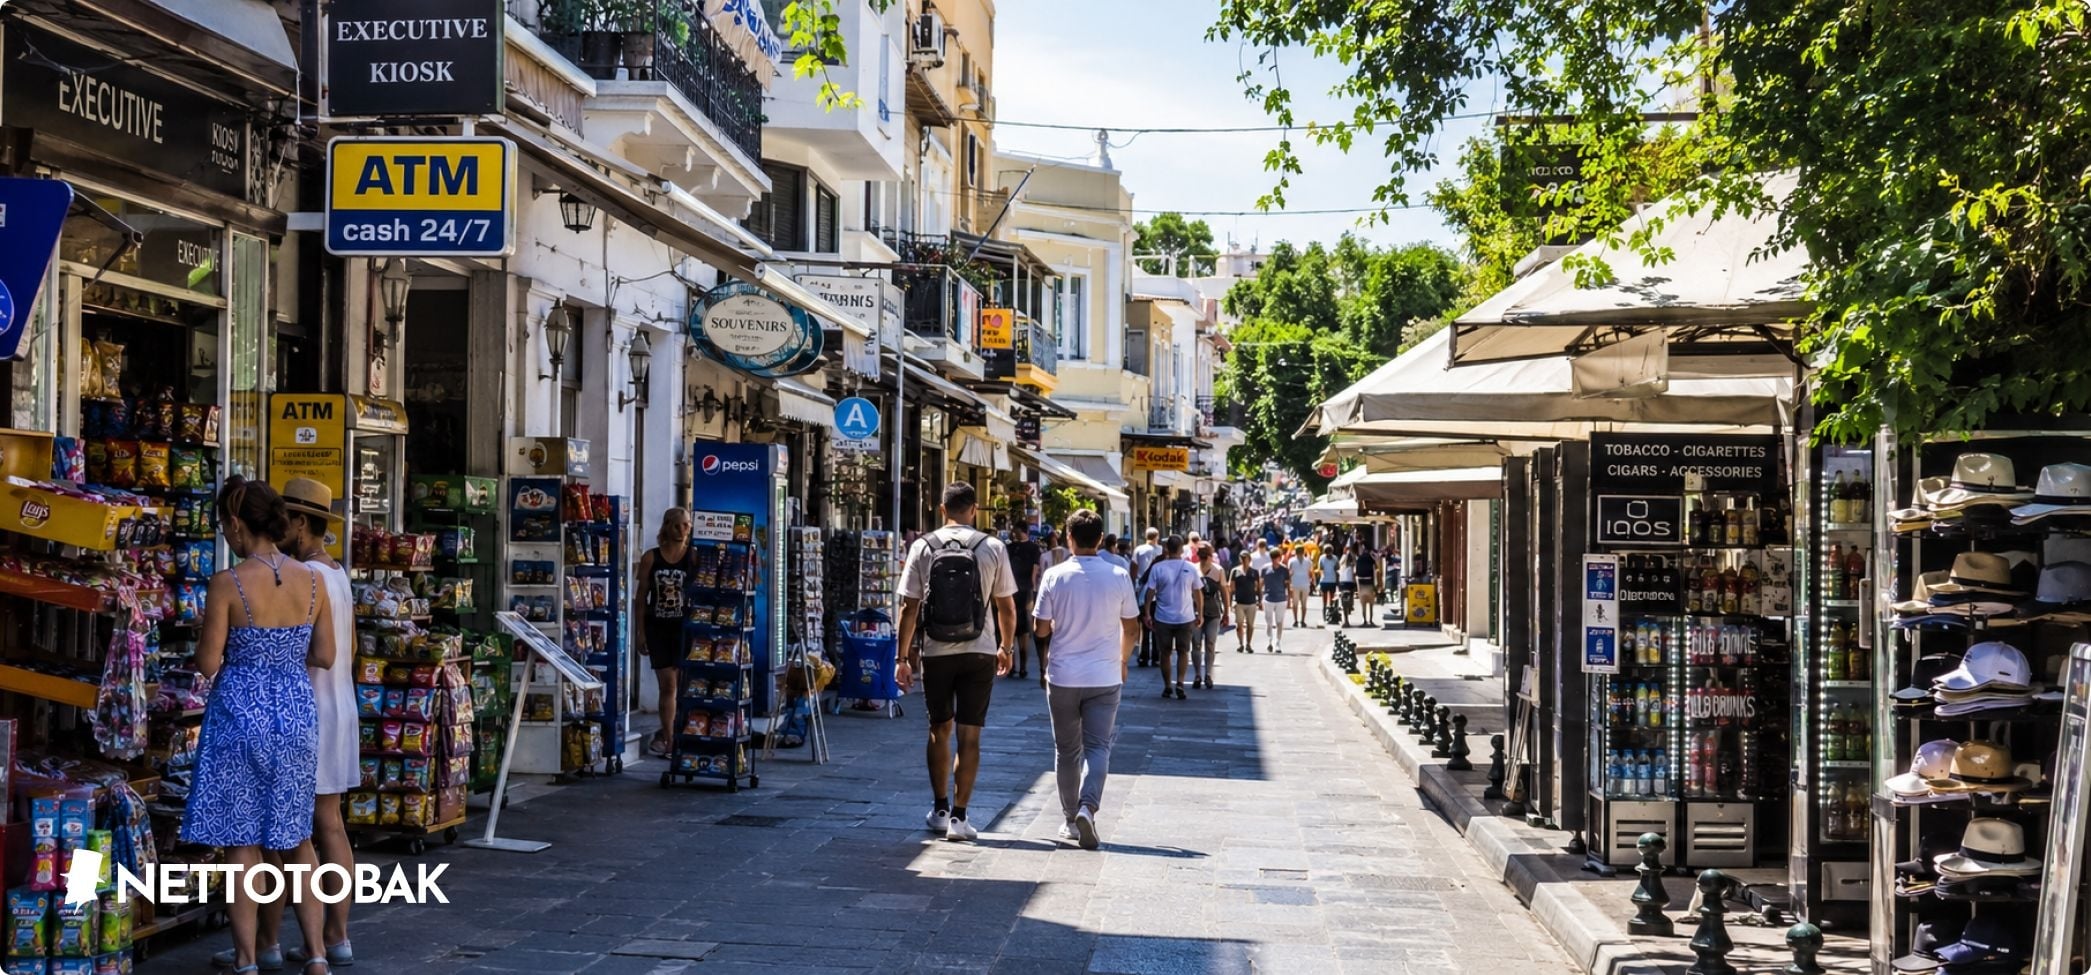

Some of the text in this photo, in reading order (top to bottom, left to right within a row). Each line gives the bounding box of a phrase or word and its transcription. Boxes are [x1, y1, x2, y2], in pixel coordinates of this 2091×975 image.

[337, 16, 488, 41] EXECUTIVE
[370, 60, 454, 83] KIOSK
[59, 70, 164, 144] EXECUTIVE
[354, 155, 479, 196] ATM
[343, 218, 490, 245] cash 24/7
[710, 317, 788, 333] SOUVENIRS
[281, 402, 333, 420] ATM
[843, 403, 868, 429] A
[1605, 444, 1670, 457] TOBACCO
[1683, 445, 1766, 458] CIGARETTES
[722, 459, 758, 473] pepsi
[1607, 464, 1658, 477] CIGARS
